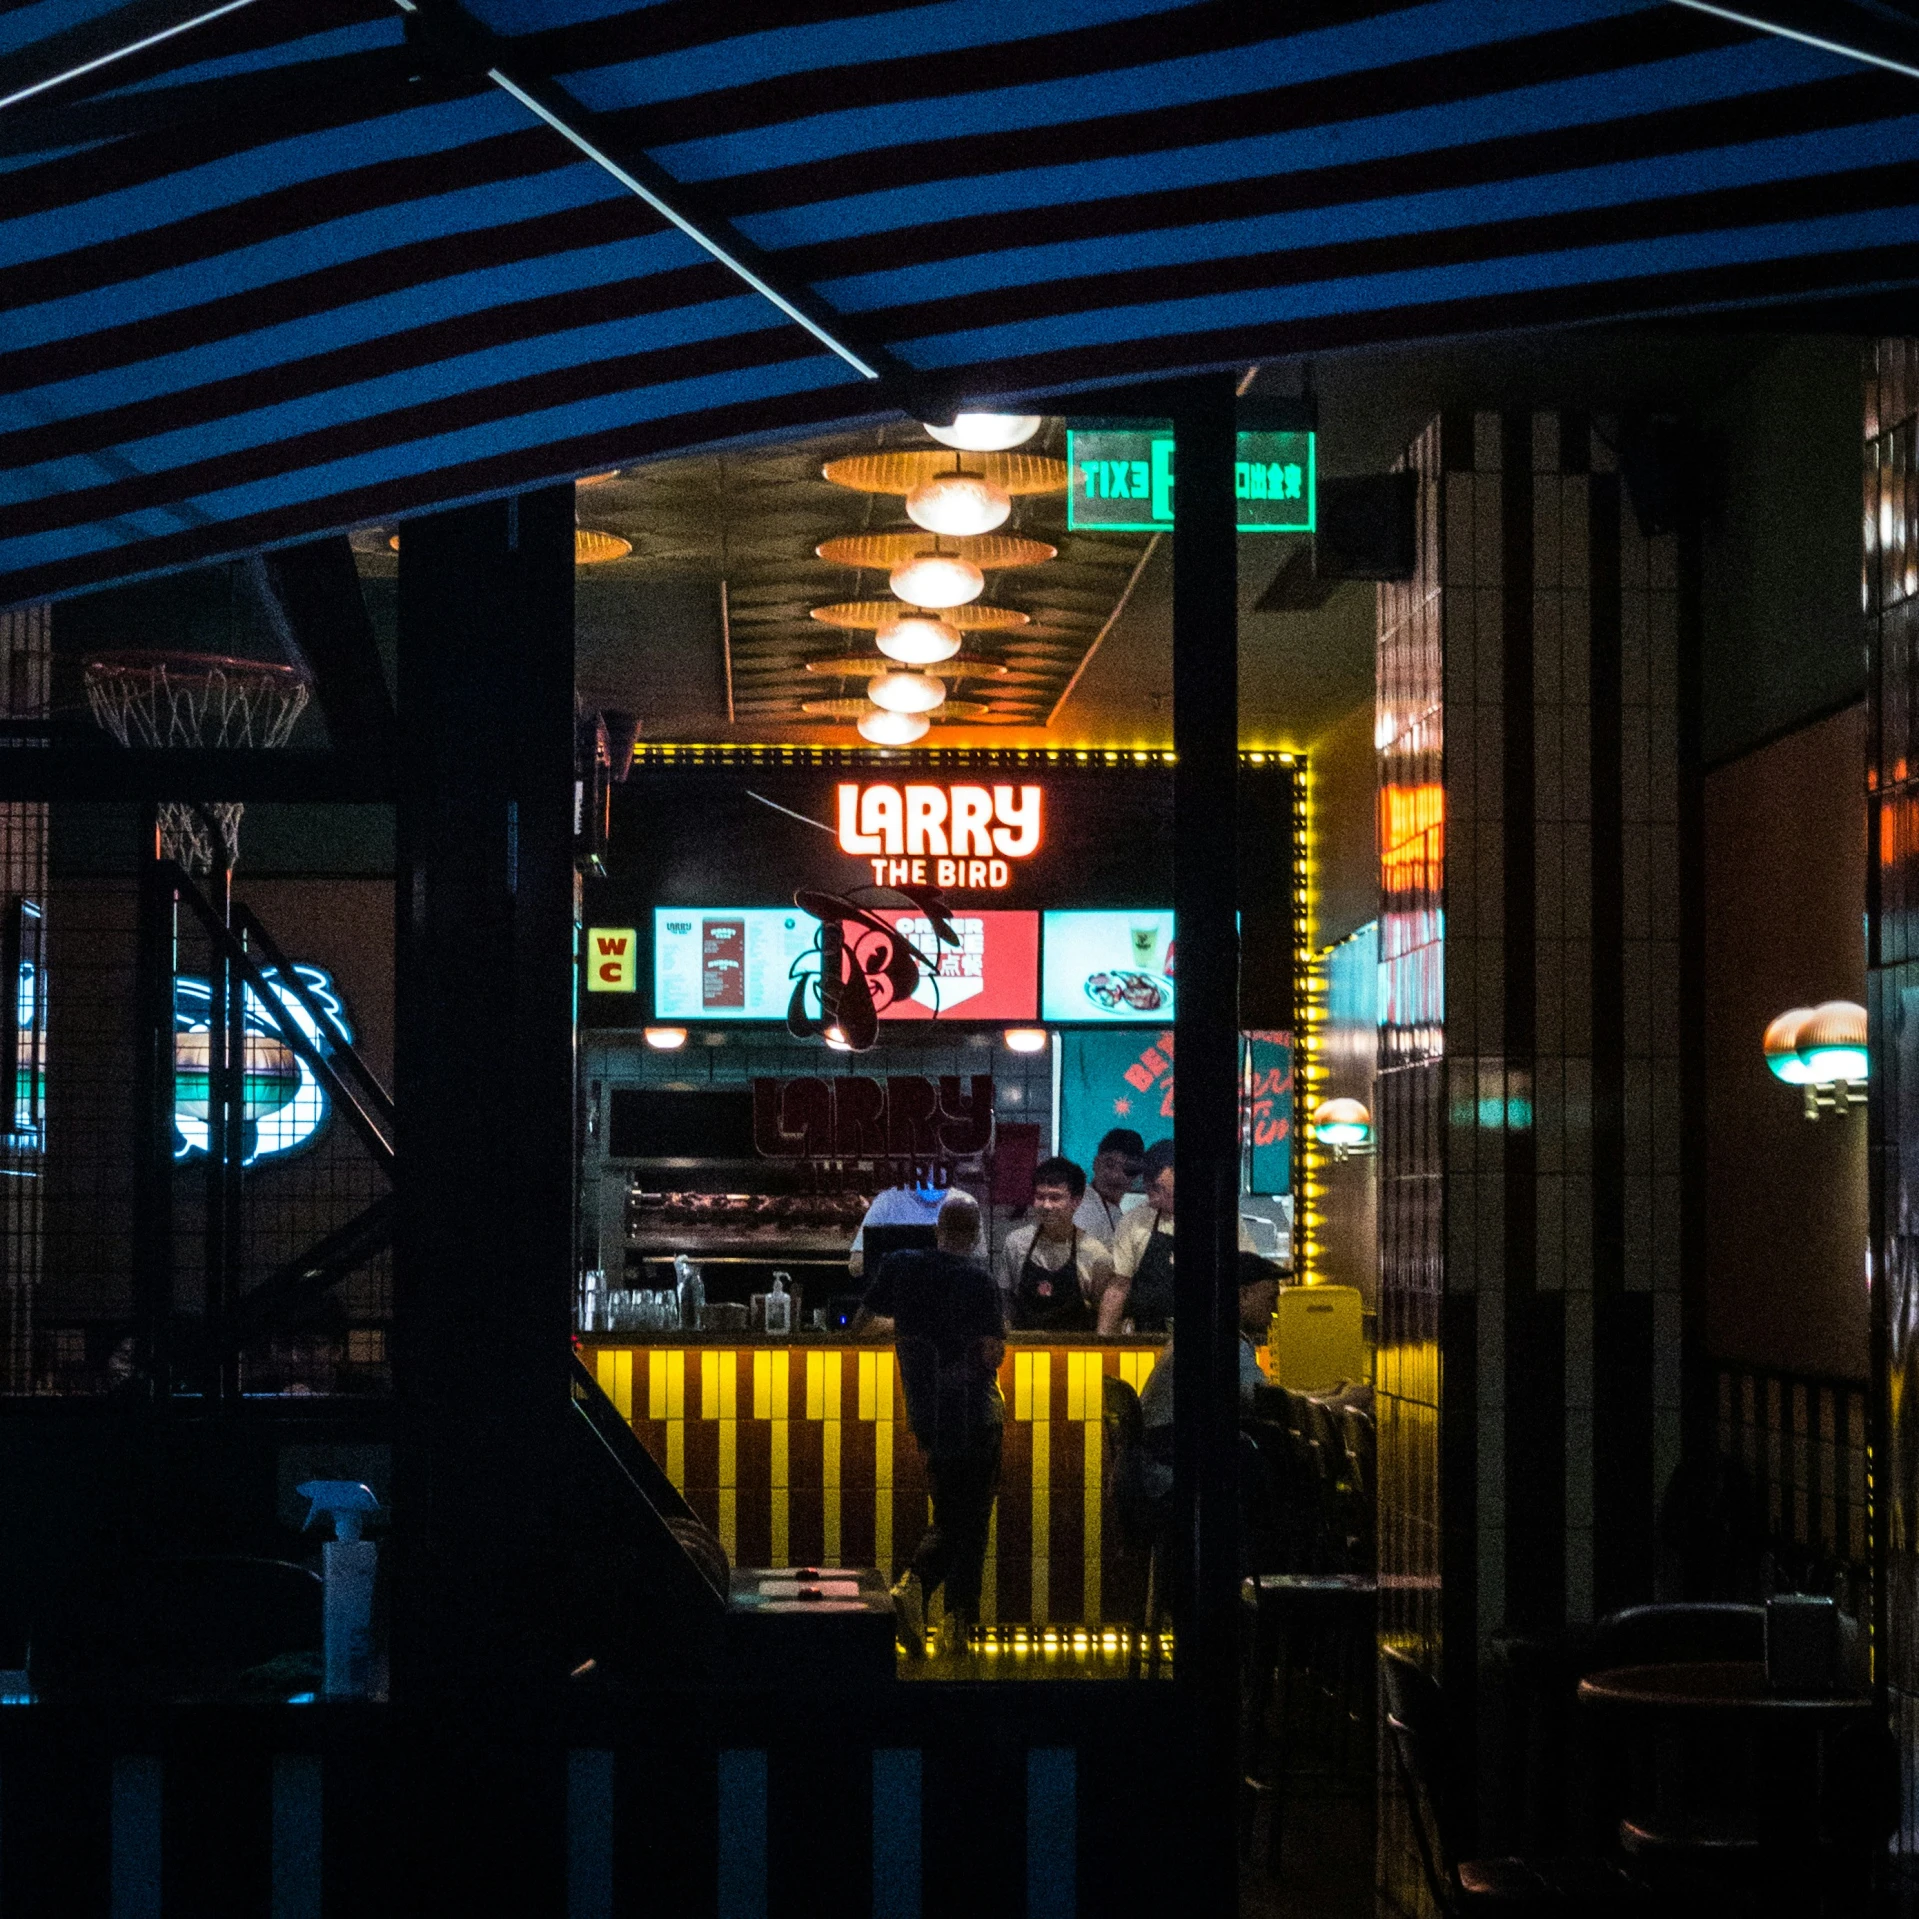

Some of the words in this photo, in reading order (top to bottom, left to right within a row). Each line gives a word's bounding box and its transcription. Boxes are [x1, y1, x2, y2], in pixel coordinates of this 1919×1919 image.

[837, 784, 1042, 857] LARRY
[872, 859, 926, 887] THE
[938, 860, 1008, 888] BIRD
[895, 917, 984, 934] ORER
[752, 1076, 996, 1157] LARRY
